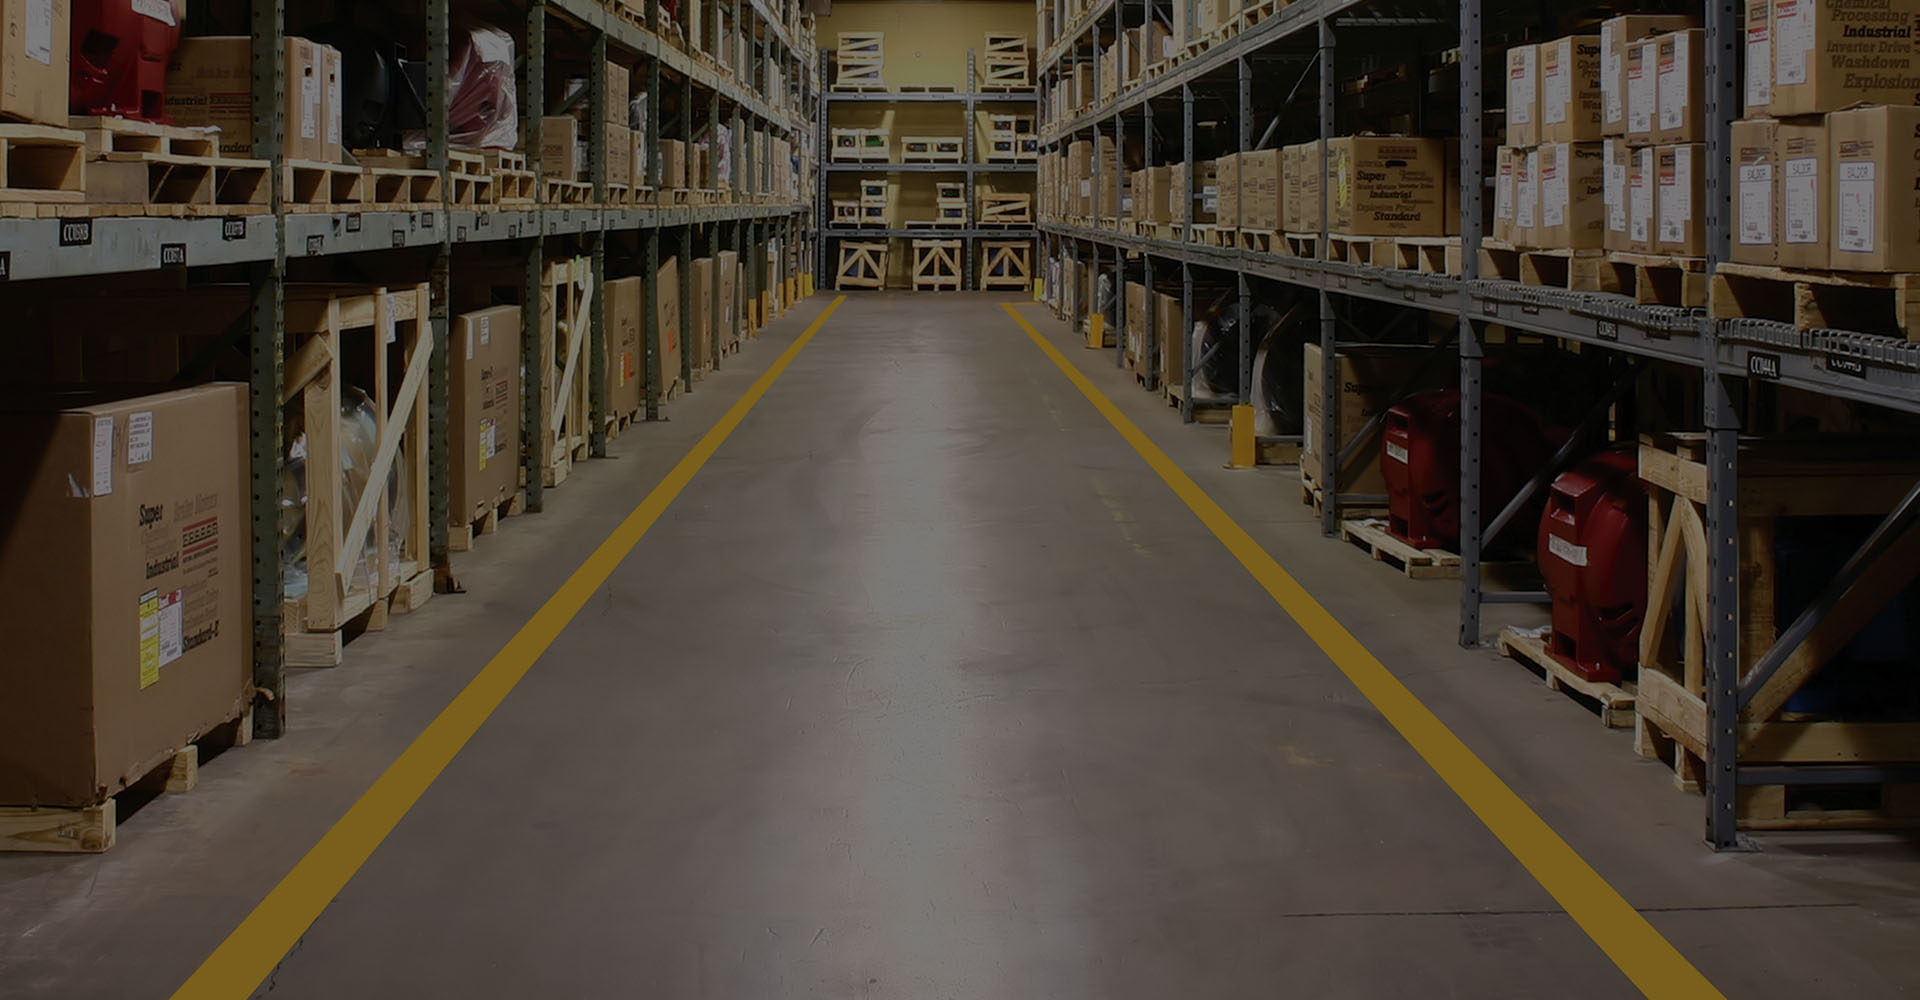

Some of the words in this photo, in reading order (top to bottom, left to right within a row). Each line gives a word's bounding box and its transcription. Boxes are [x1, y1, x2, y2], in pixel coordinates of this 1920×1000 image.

[1831, 8, 1910, 25] Processing
[1842, 25, 1911, 38] Industrial
[1825, 40, 1875, 53] Inverter
[1878, 40, 1911, 53] Drive
[1831, 55, 1910, 68] Washdown
[1842, 72, 1920, 93] Explosion
[1356, 170, 1386, 183] Super
[1369, 190, 1412, 199] Industrial
[1373, 211, 1421, 221] Standard
[139, 503, 163, 529] Super
[146, 551, 179, 579] Industrial
